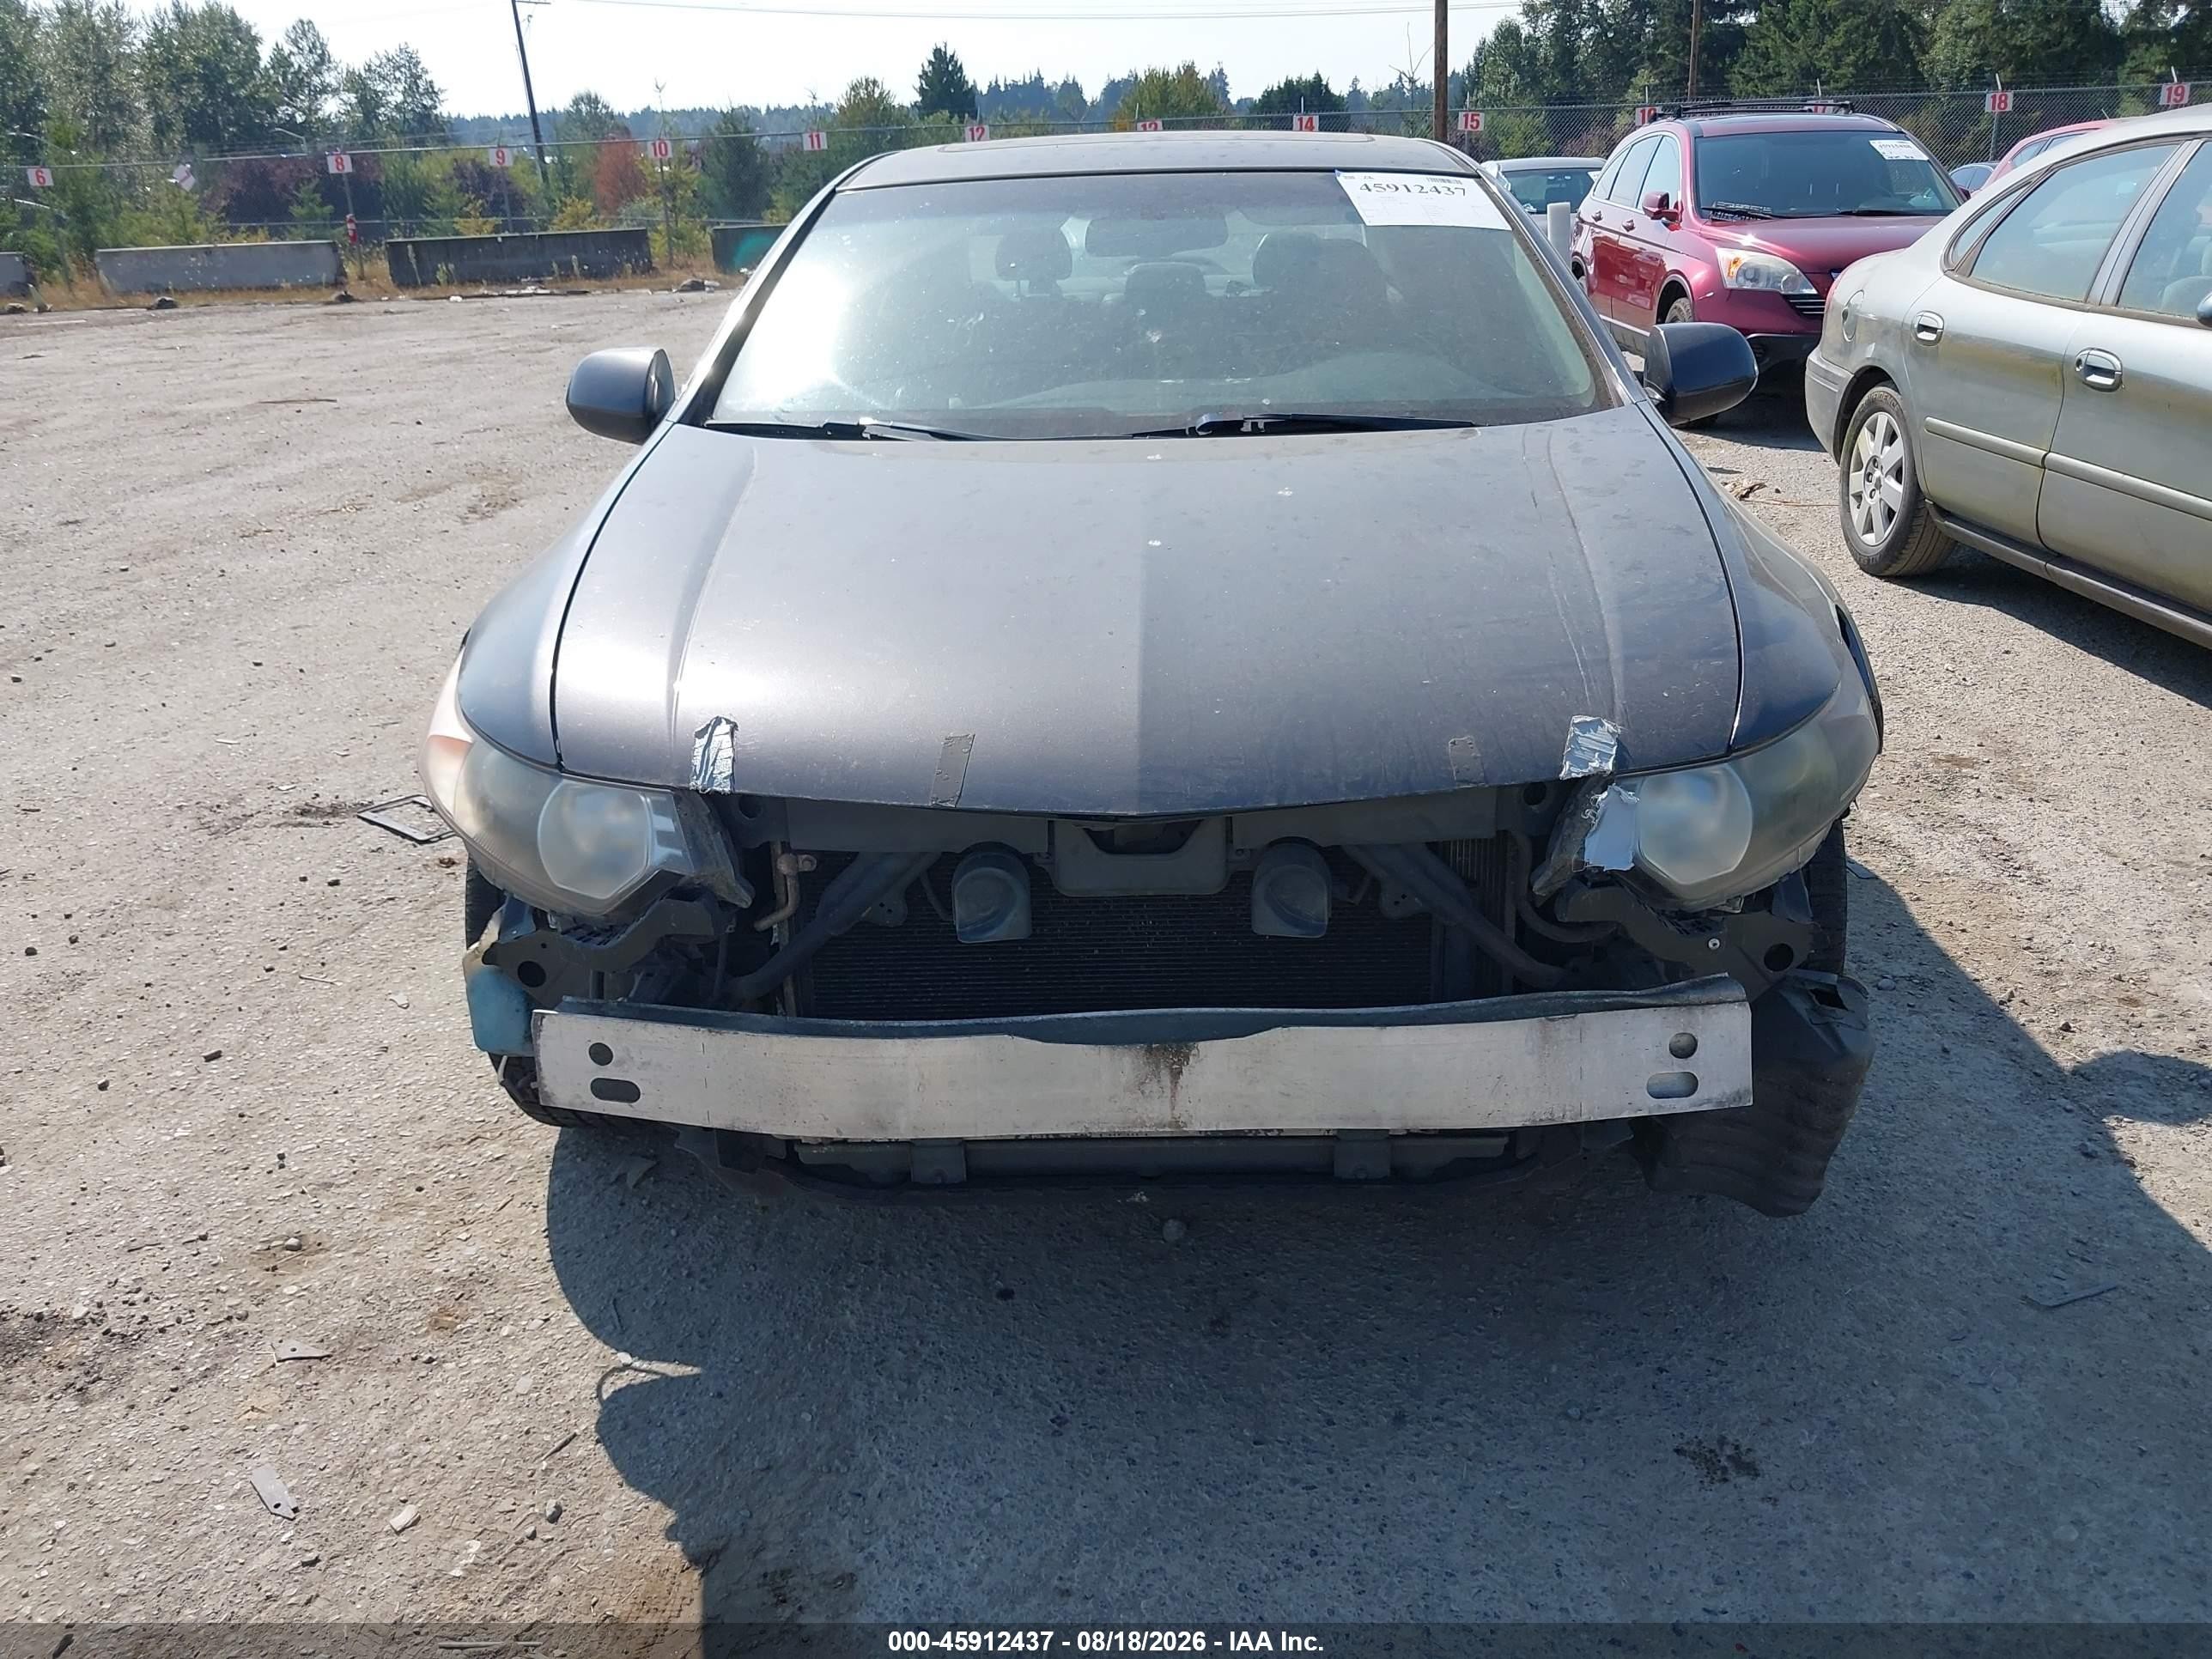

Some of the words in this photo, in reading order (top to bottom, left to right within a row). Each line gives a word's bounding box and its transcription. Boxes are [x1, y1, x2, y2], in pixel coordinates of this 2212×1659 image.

[1991, 94, 2008, 111] 18
[2166, 85, 2185, 103] 19
[1297, 116, 1315, 131] 14
[1463, 112, 1480, 130] 15
[809, 132, 821, 149] 11
[969, 125, 985, 142] 12
[495, 149, 505, 165] 9
[651, 141, 668, 157] 10
[335, 155, 344, 172] 8
[35, 169, 46, 185] 6
[1360, 183, 1466, 197] 45912437
